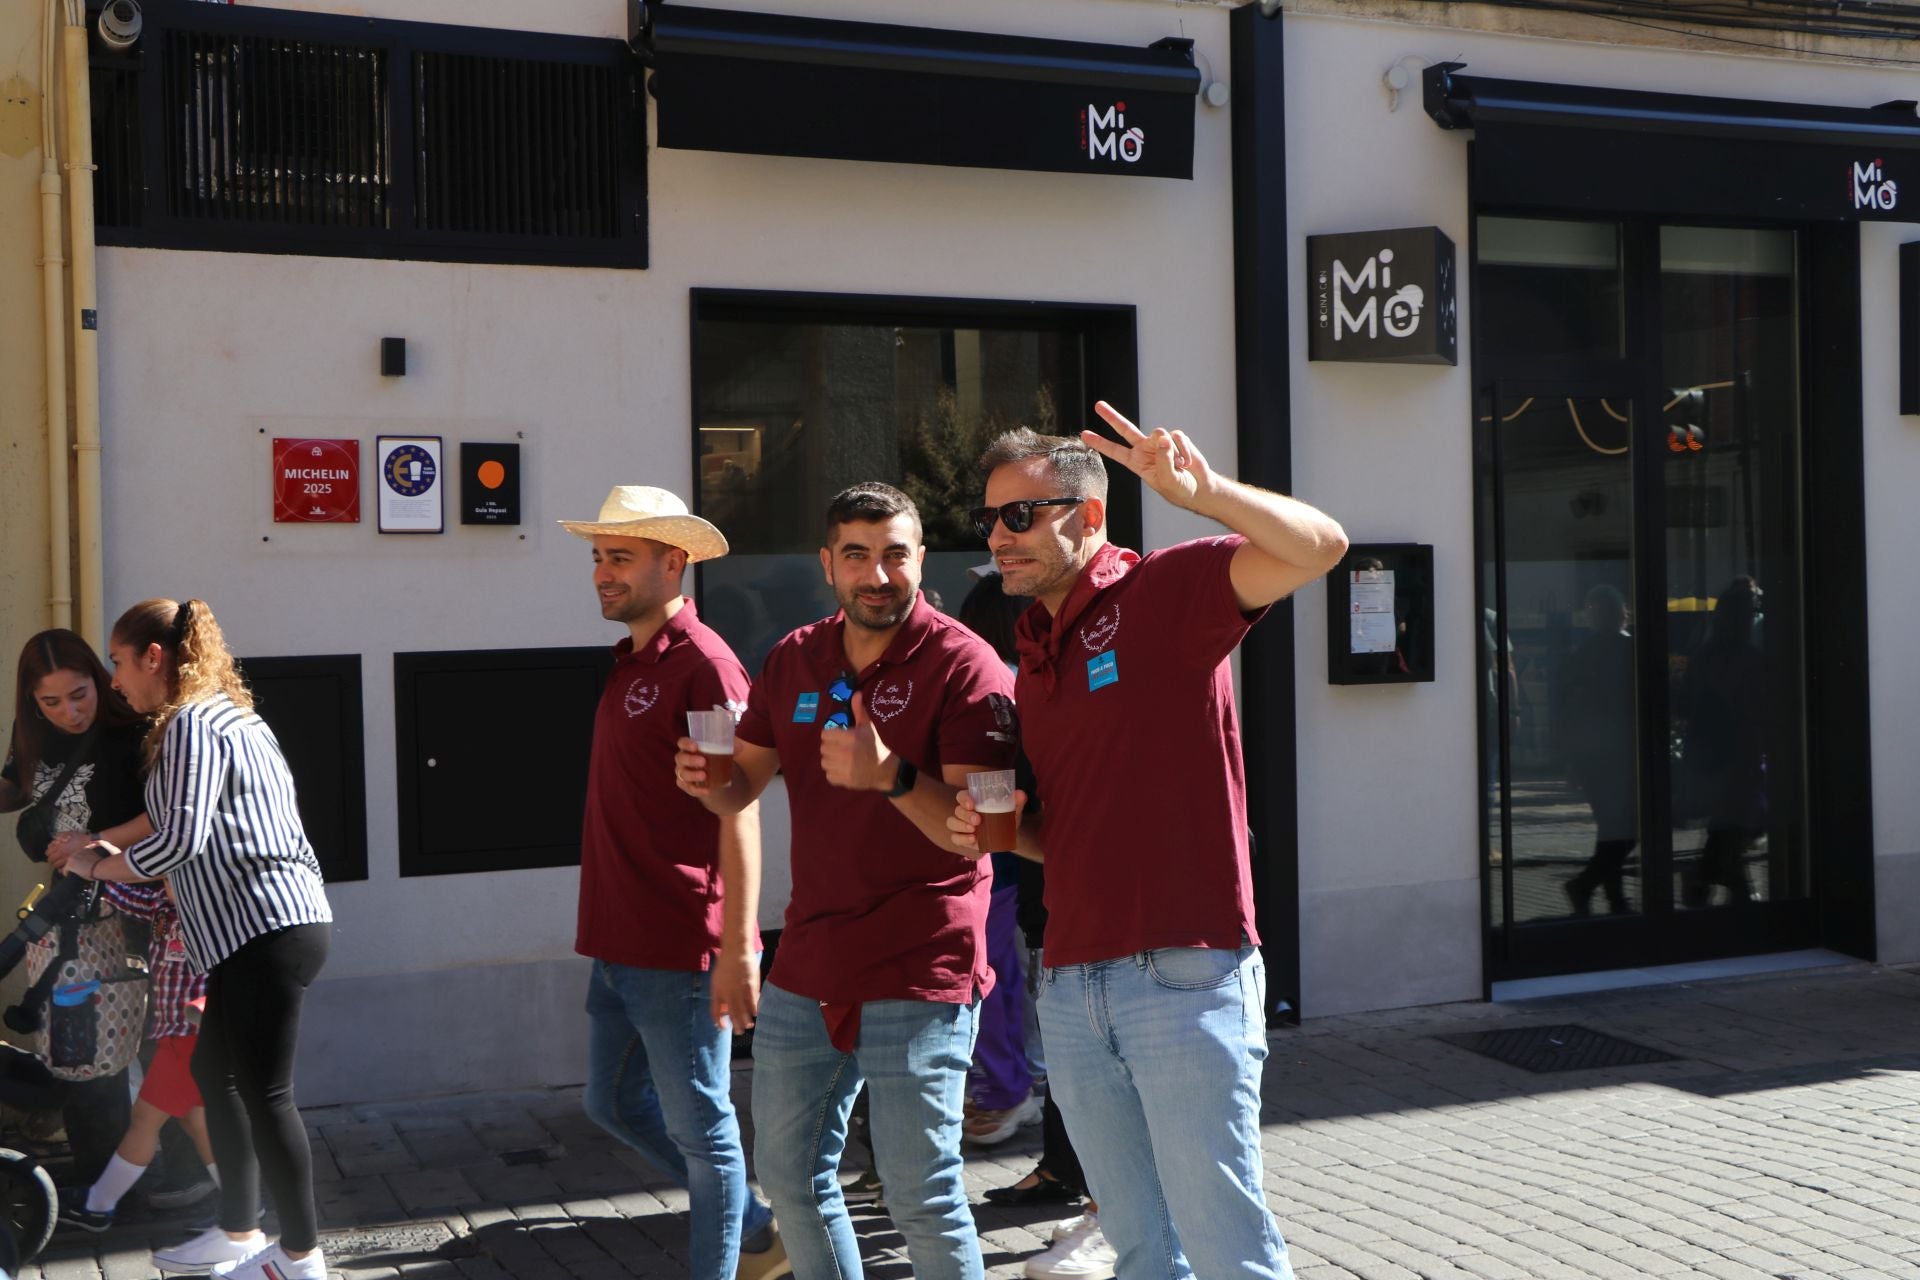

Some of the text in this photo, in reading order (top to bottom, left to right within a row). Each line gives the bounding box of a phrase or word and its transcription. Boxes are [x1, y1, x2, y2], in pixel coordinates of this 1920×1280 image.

[1088, 101, 1126, 129] Mi
[1854, 159, 1882, 183] Mi
[1333, 248, 1394, 294] Mi
[284, 468, 349, 480] MICHELIN
[303, 483, 333, 494] 2025
